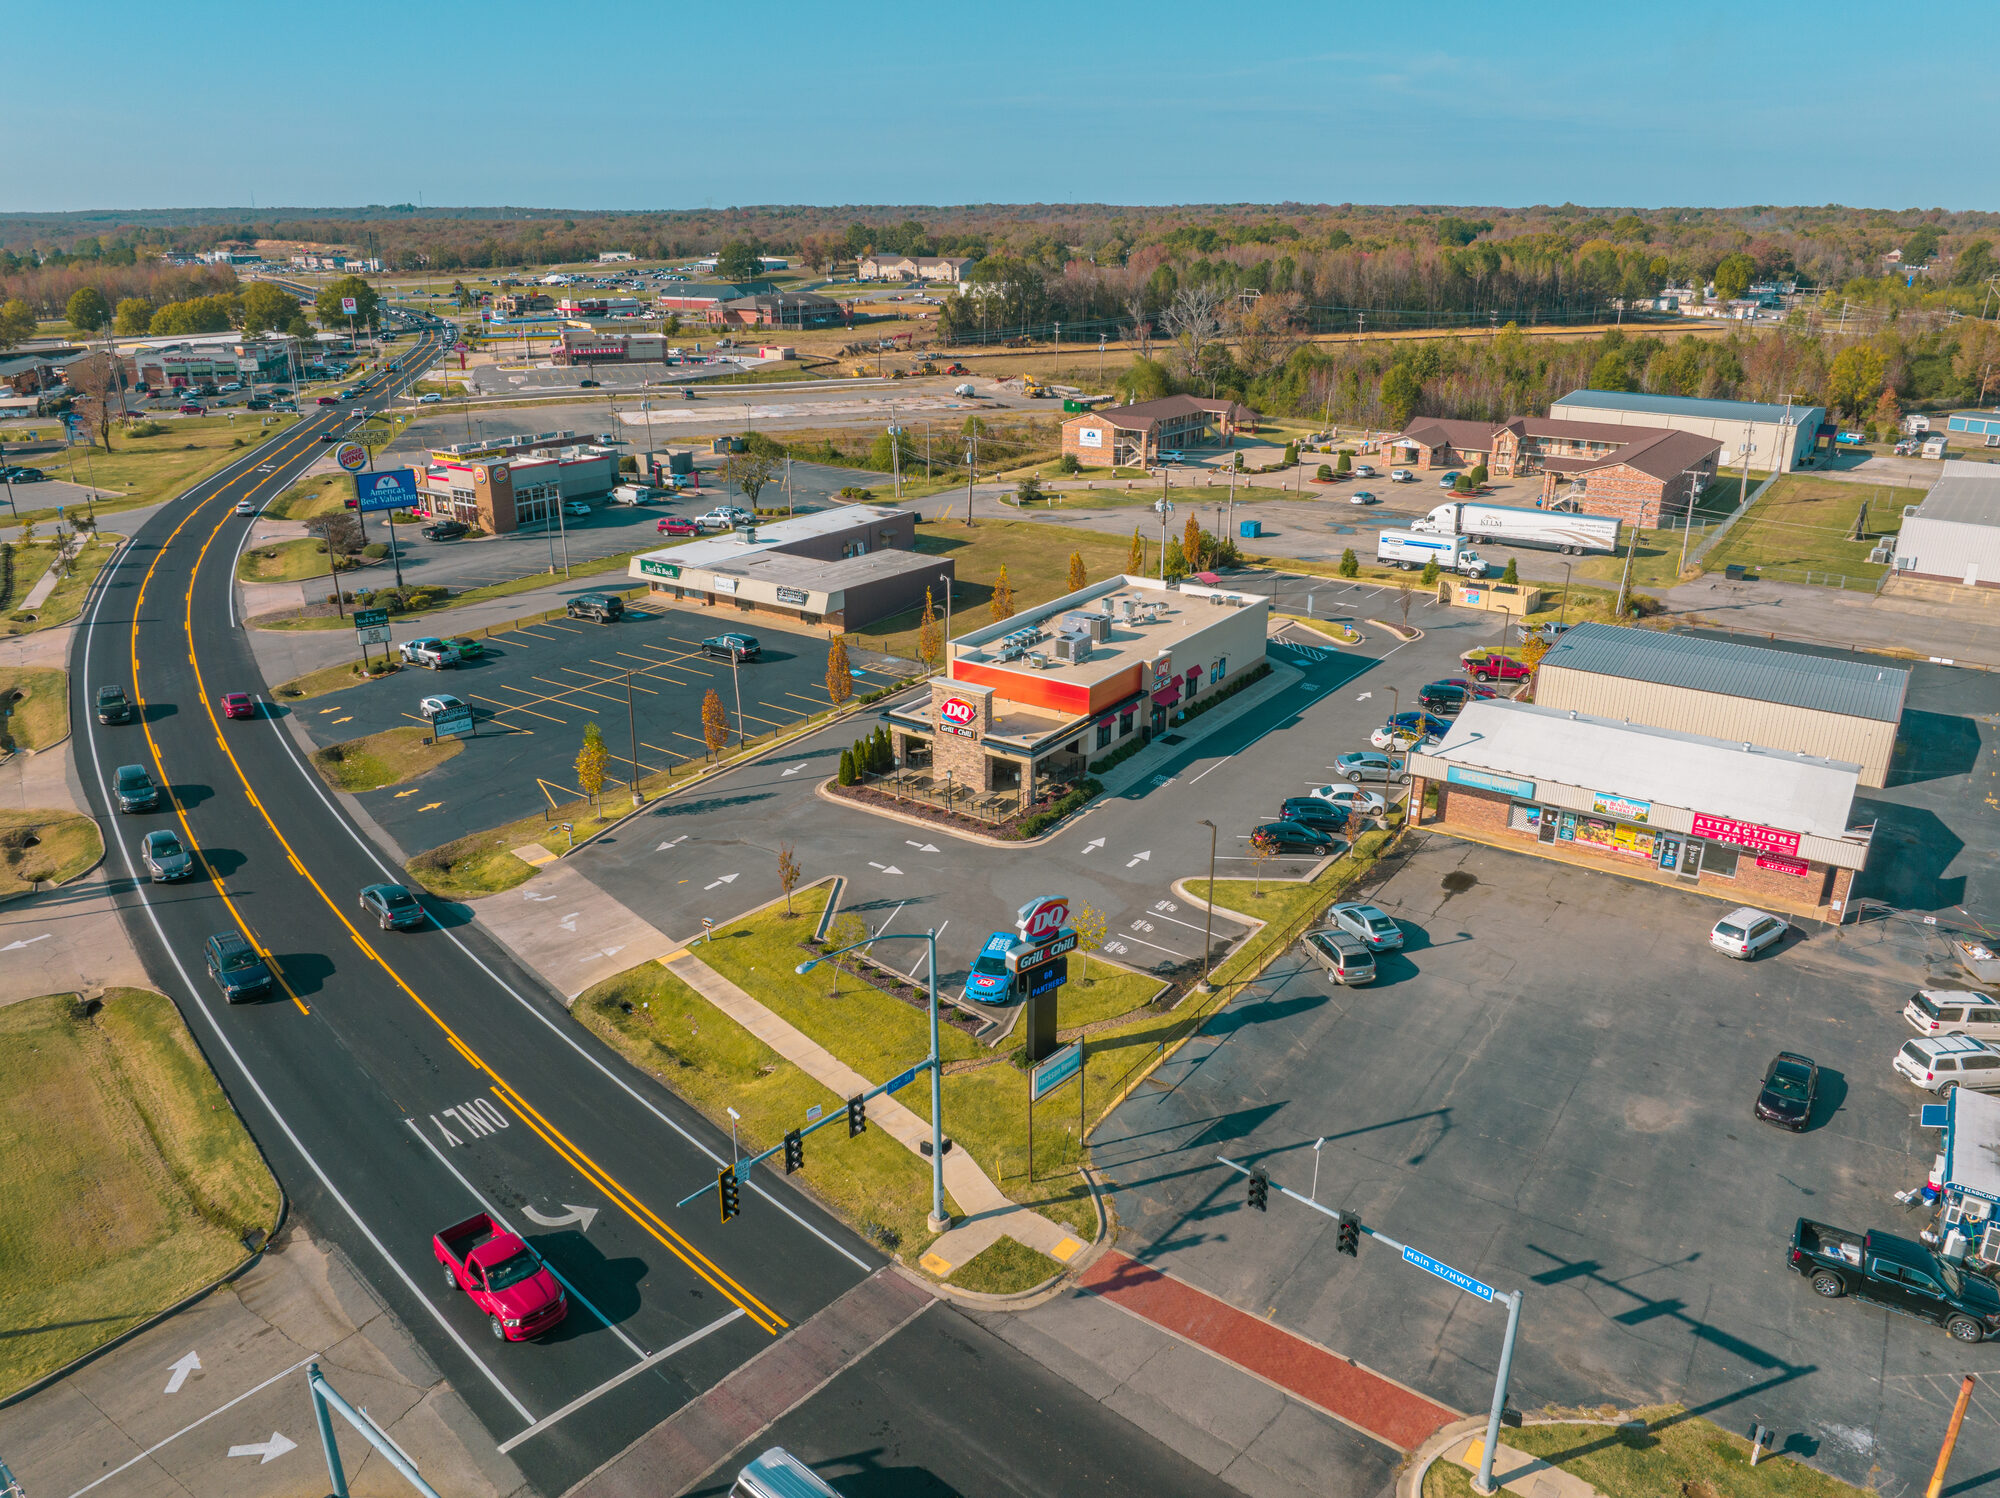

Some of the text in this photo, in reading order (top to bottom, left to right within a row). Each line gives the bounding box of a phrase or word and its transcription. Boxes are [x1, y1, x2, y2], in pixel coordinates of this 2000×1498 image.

[341, 448, 362, 460] BURGER
[343, 453, 365, 466] KING
[361, 493, 417, 506] Best Value Inn
[645, 565, 657, 573] Neck
[662, 568, 673, 576] Back
[946, 702, 970, 721] DQ
[941, 725, 972, 738] Grill Chill
[1459, 769, 1519, 791] Jackson Hewitt
[1609, 806, 1634, 815] MARKET
[1696, 819, 1797, 846] ATTRACTIONS
[1736, 821, 1757, 830] MAIN
[1717, 834, 1770, 851] 843.4373
[1032, 906, 1064, 934] DQ
[1020, 952, 1043, 969] Grill
[1051, 936, 1075, 956] Chill
[1044, 970, 1053, 979] GO
[1032, 976, 1066, 997] PANTHERS!
[1040, 1068, 1060, 1086] Jackson
[430, 1098, 509, 1147] ONLY
[1964, 1187, 1998, 1201] BENDICION
[1406, 1250, 1489, 1296] Main St/HWY 89
